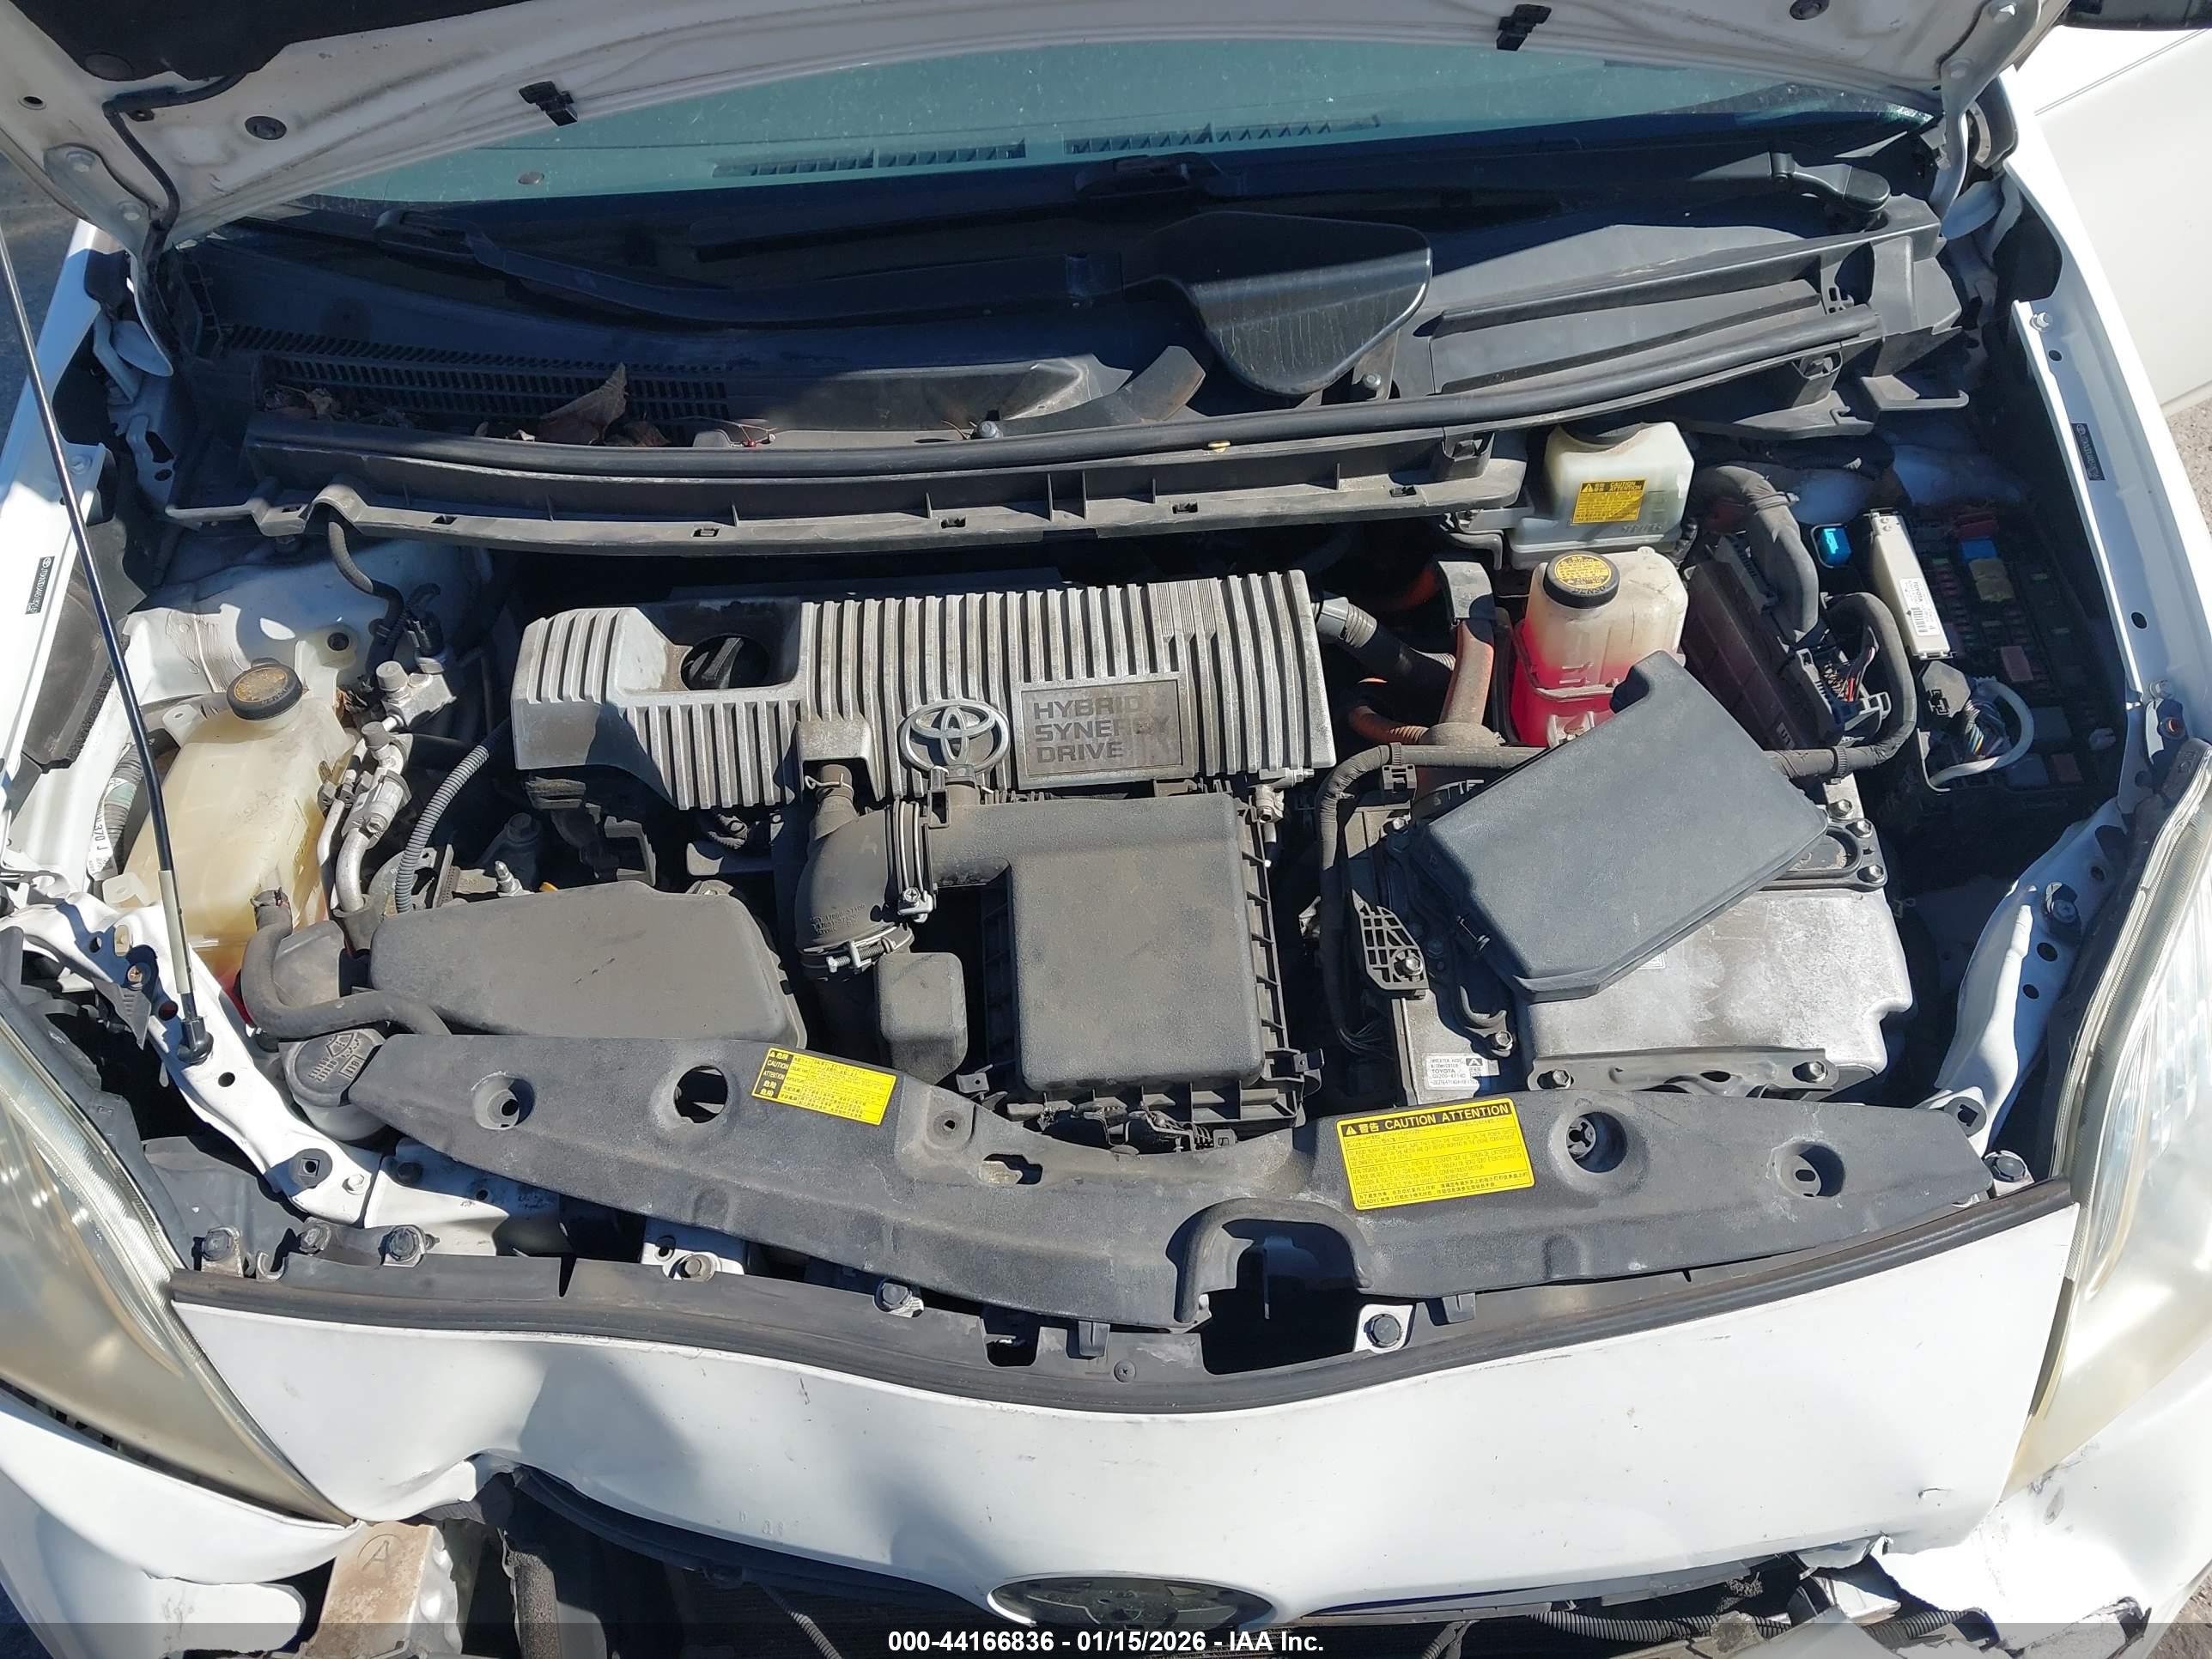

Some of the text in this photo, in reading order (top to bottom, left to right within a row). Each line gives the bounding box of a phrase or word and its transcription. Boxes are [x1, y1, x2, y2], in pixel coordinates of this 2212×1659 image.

[1033, 695, 1141, 720] HYBRID
[1036, 741, 1124, 763] DRIVE
[763, 1070, 786, 1080] ATTENTION
[767, 1060, 789, 1070] CAUTION
[1358, 1103, 1510, 1133] 警告 CAUTION ATTENTION
